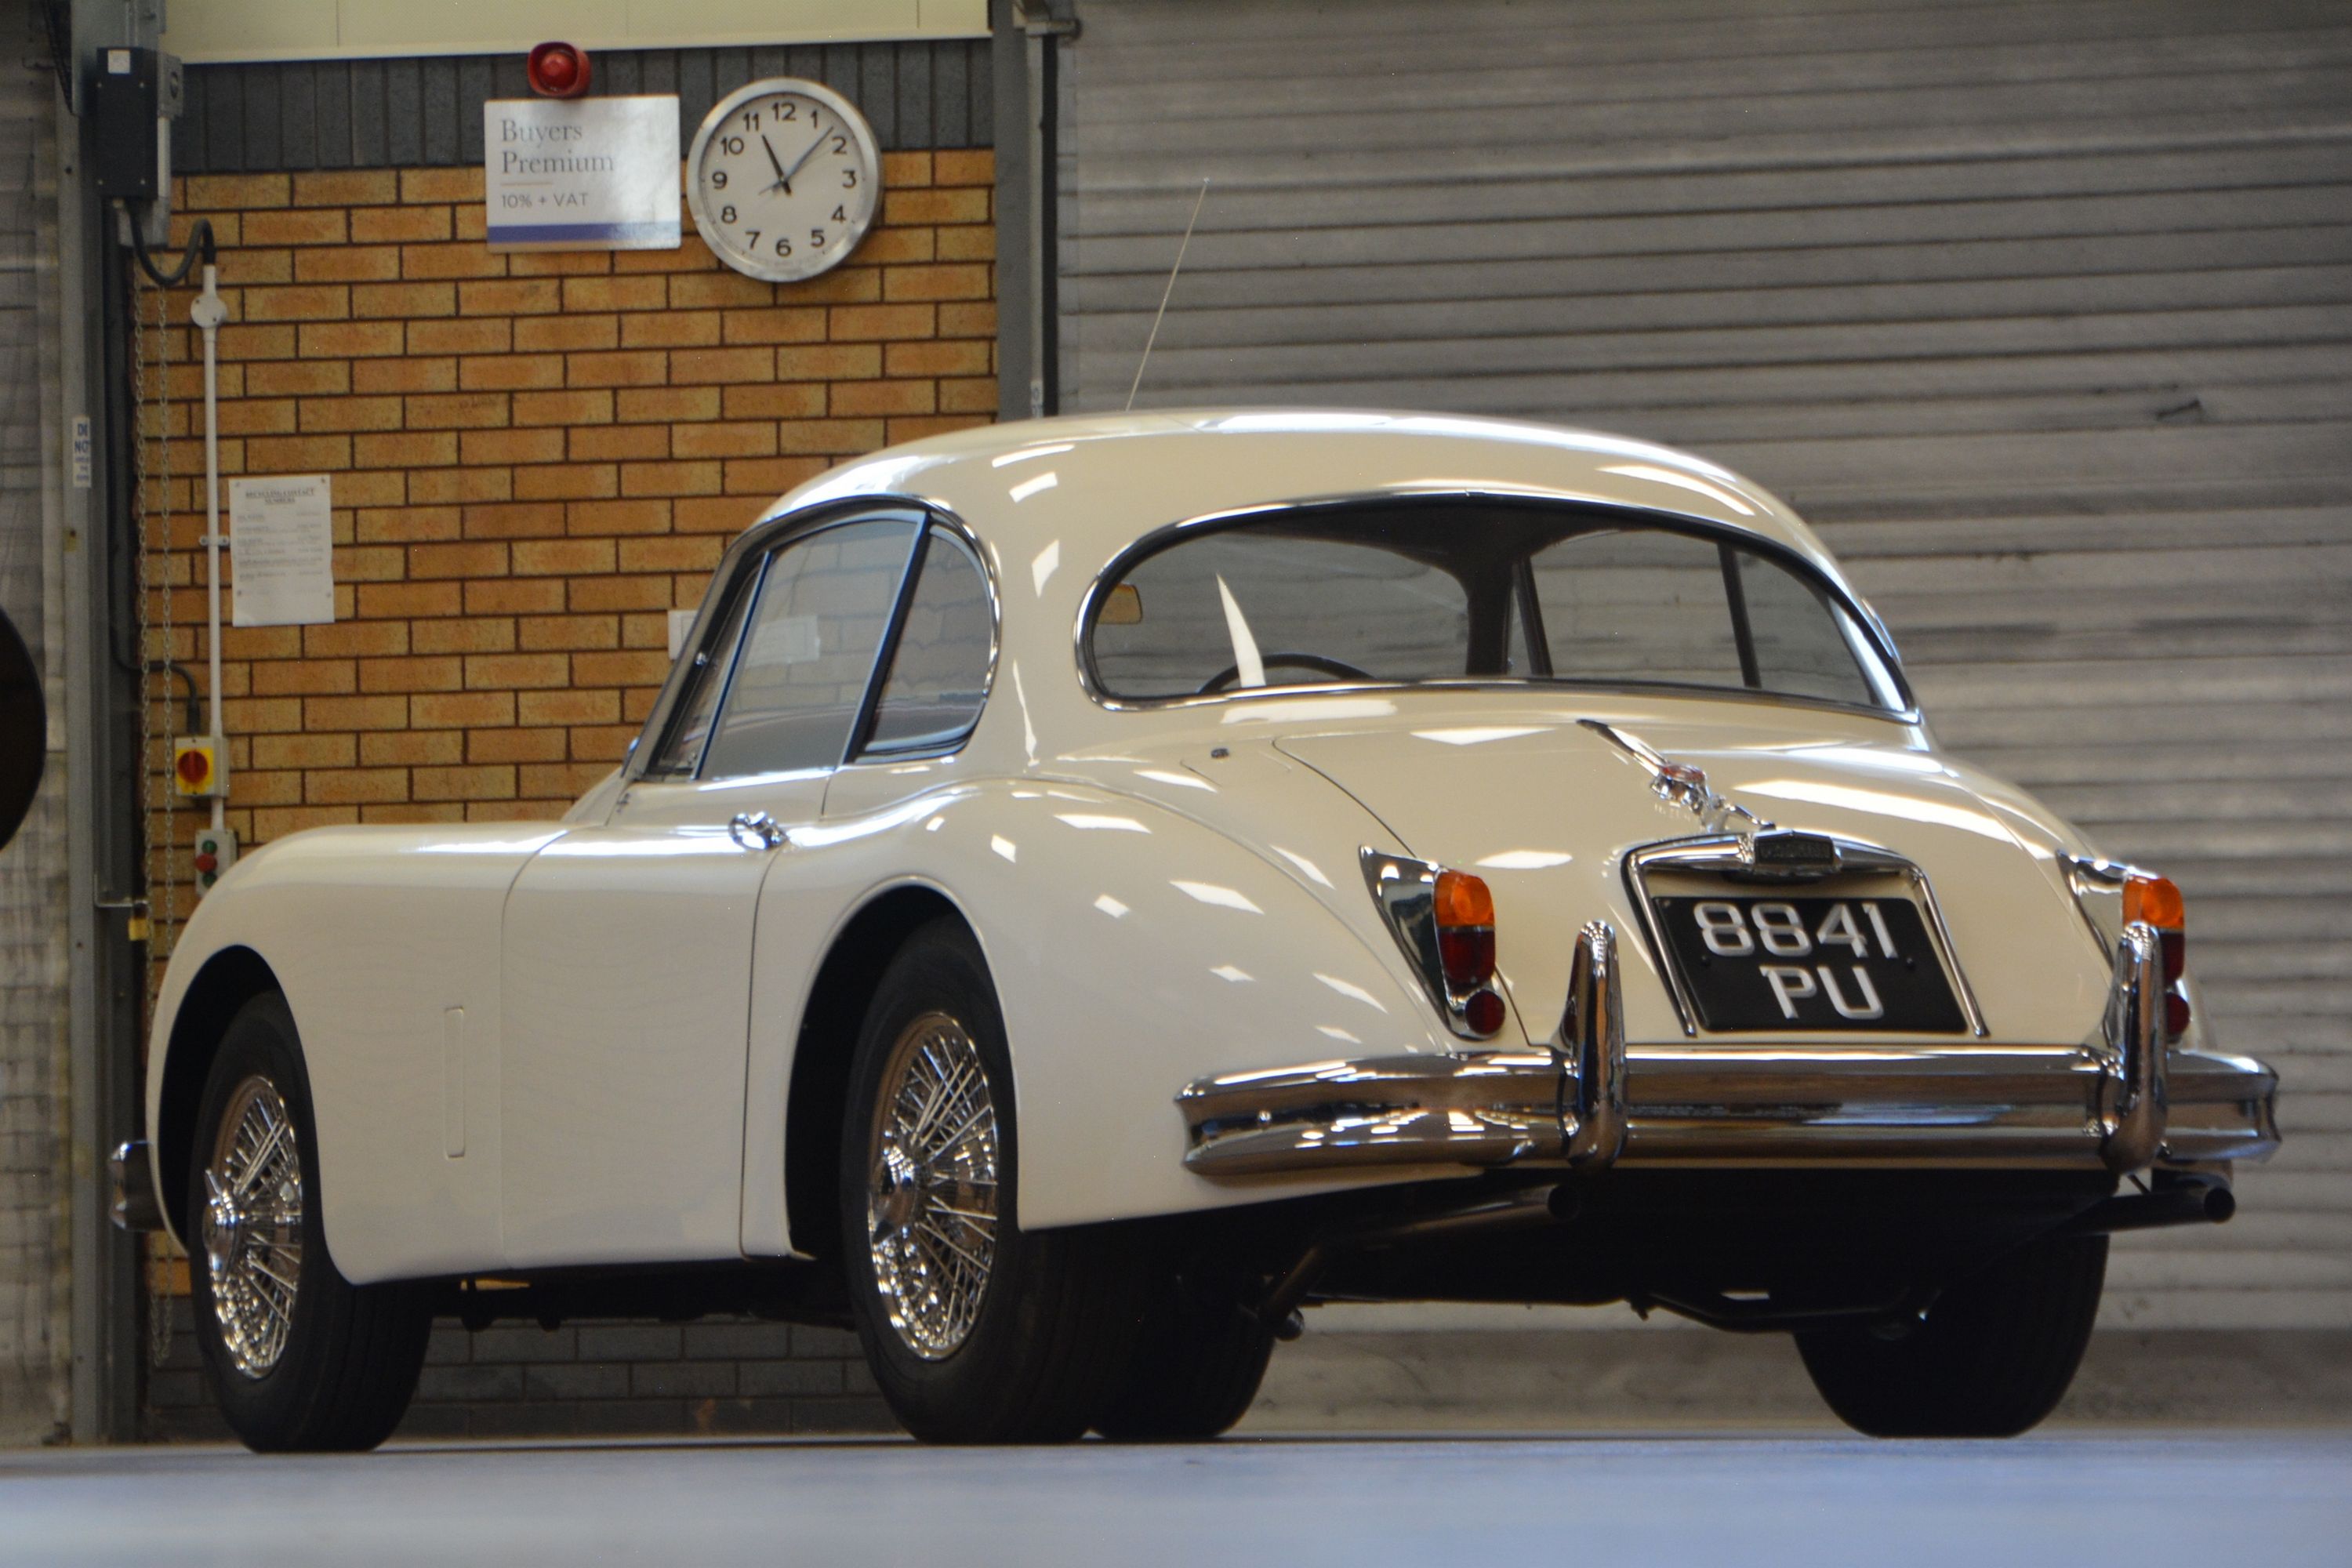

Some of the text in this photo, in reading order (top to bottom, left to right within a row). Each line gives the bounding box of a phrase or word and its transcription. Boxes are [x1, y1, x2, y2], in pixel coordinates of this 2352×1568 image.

[742, 111, 760, 132] 11
[769, 100, 798, 122] 12
[810, 107, 820, 129] 1
[501, 119, 583, 148] Buyers
[718, 134, 745, 156] 10
[831, 134, 848, 155] 2
[501, 149, 615, 174] Premium
[711, 170, 728, 191] 9
[842, 169, 857, 189] 3
[502, 194, 532, 209] 10%
[552, 192, 590, 208] VAT
[720, 205, 738, 225] 8
[831, 204, 847, 223] 4
[745, 230, 761, 249] 7
[775, 238, 792, 257] 6
[811, 228, 826, 248] 5
[1693, 902, 1898, 959] 8841
[1759, 965, 1884, 1020] PU
